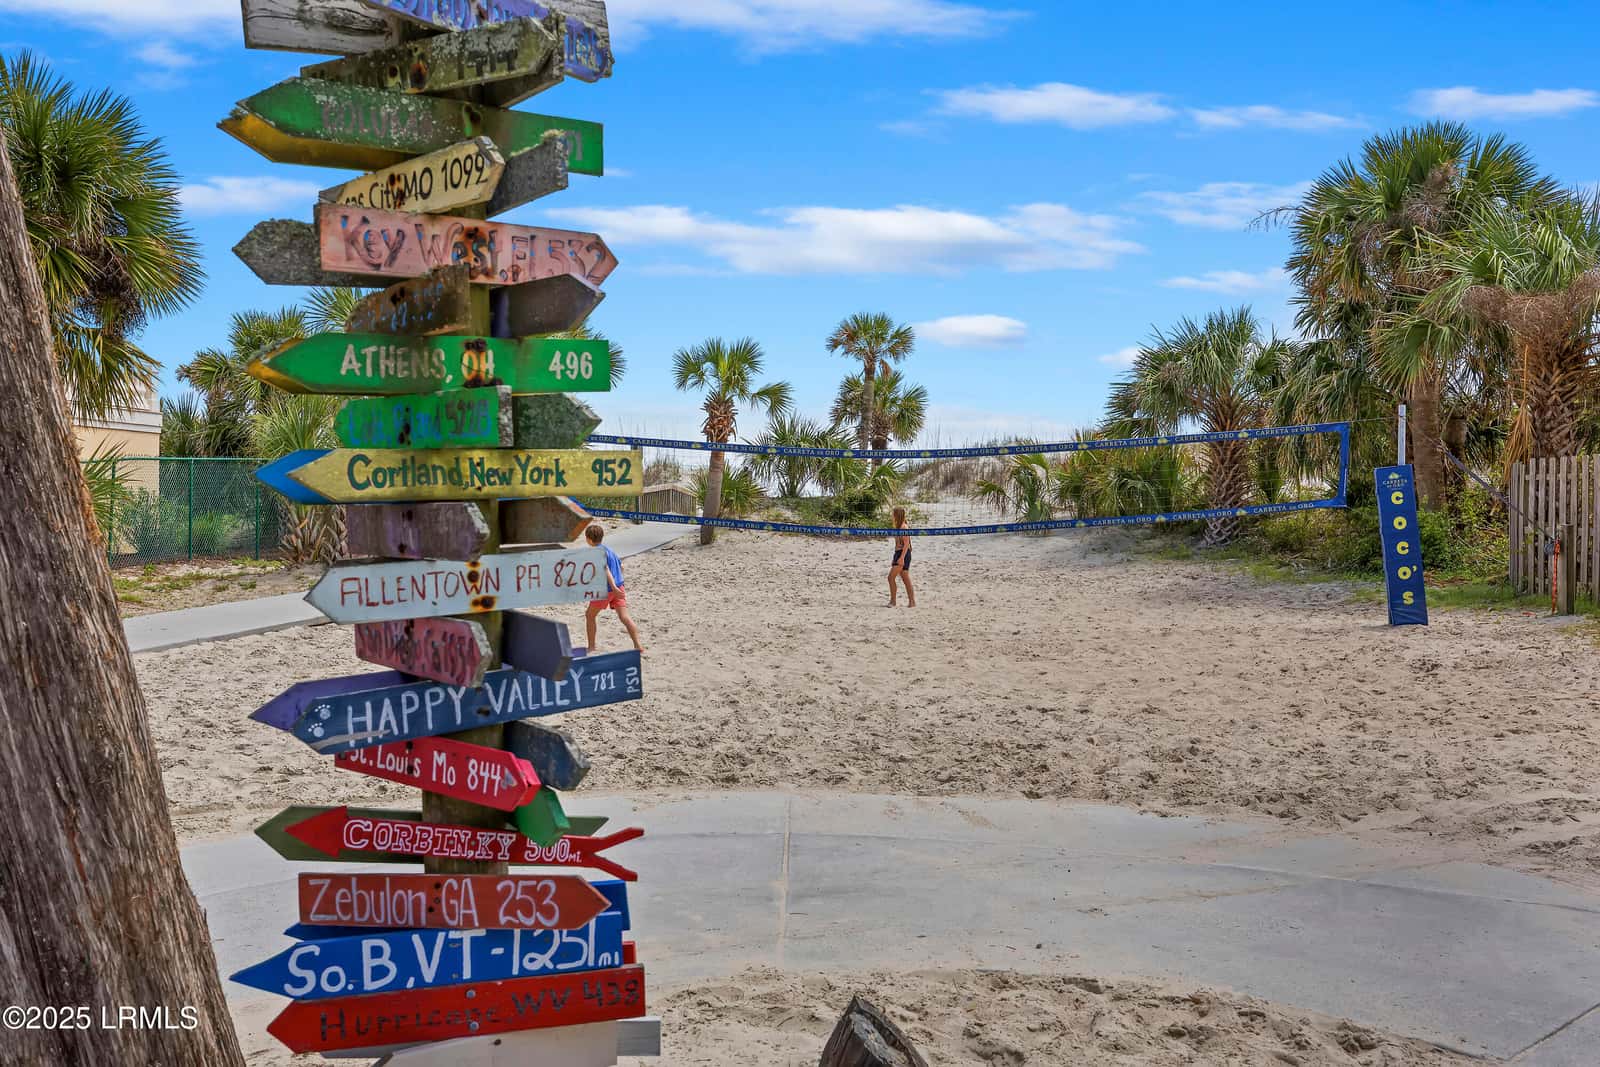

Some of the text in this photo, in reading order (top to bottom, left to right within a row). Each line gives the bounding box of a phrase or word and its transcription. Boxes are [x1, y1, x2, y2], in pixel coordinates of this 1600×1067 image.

[441, 154, 488, 192] 1099
[340, 344, 593, 383] ATHENS, OH 496
[512, 453, 567, 488] York
[591, 458, 632, 486] 952
[704, 519, 735, 527] CARRETA
[1093, 518, 1126, 526] CARRETA
[1173, 512, 1206, 520] CARRETA
[1253, 505, 1286, 513] CARRETA
[340, 560, 596, 607] ALLENTOWN PA 820
[625, 666, 640, 693] PSU
[347, 665, 616, 747] HAPPY VALLEY 781
[377, 744, 422, 778] Louis
[432, 750, 457, 786] Mo
[467, 758, 501, 796] 844
[308, 876, 560, 928] Zebulon GA 253
[283, 944, 355, 997] So.
[511, 987, 571, 1017] WV
[583, 979, 640, 1009] 438
